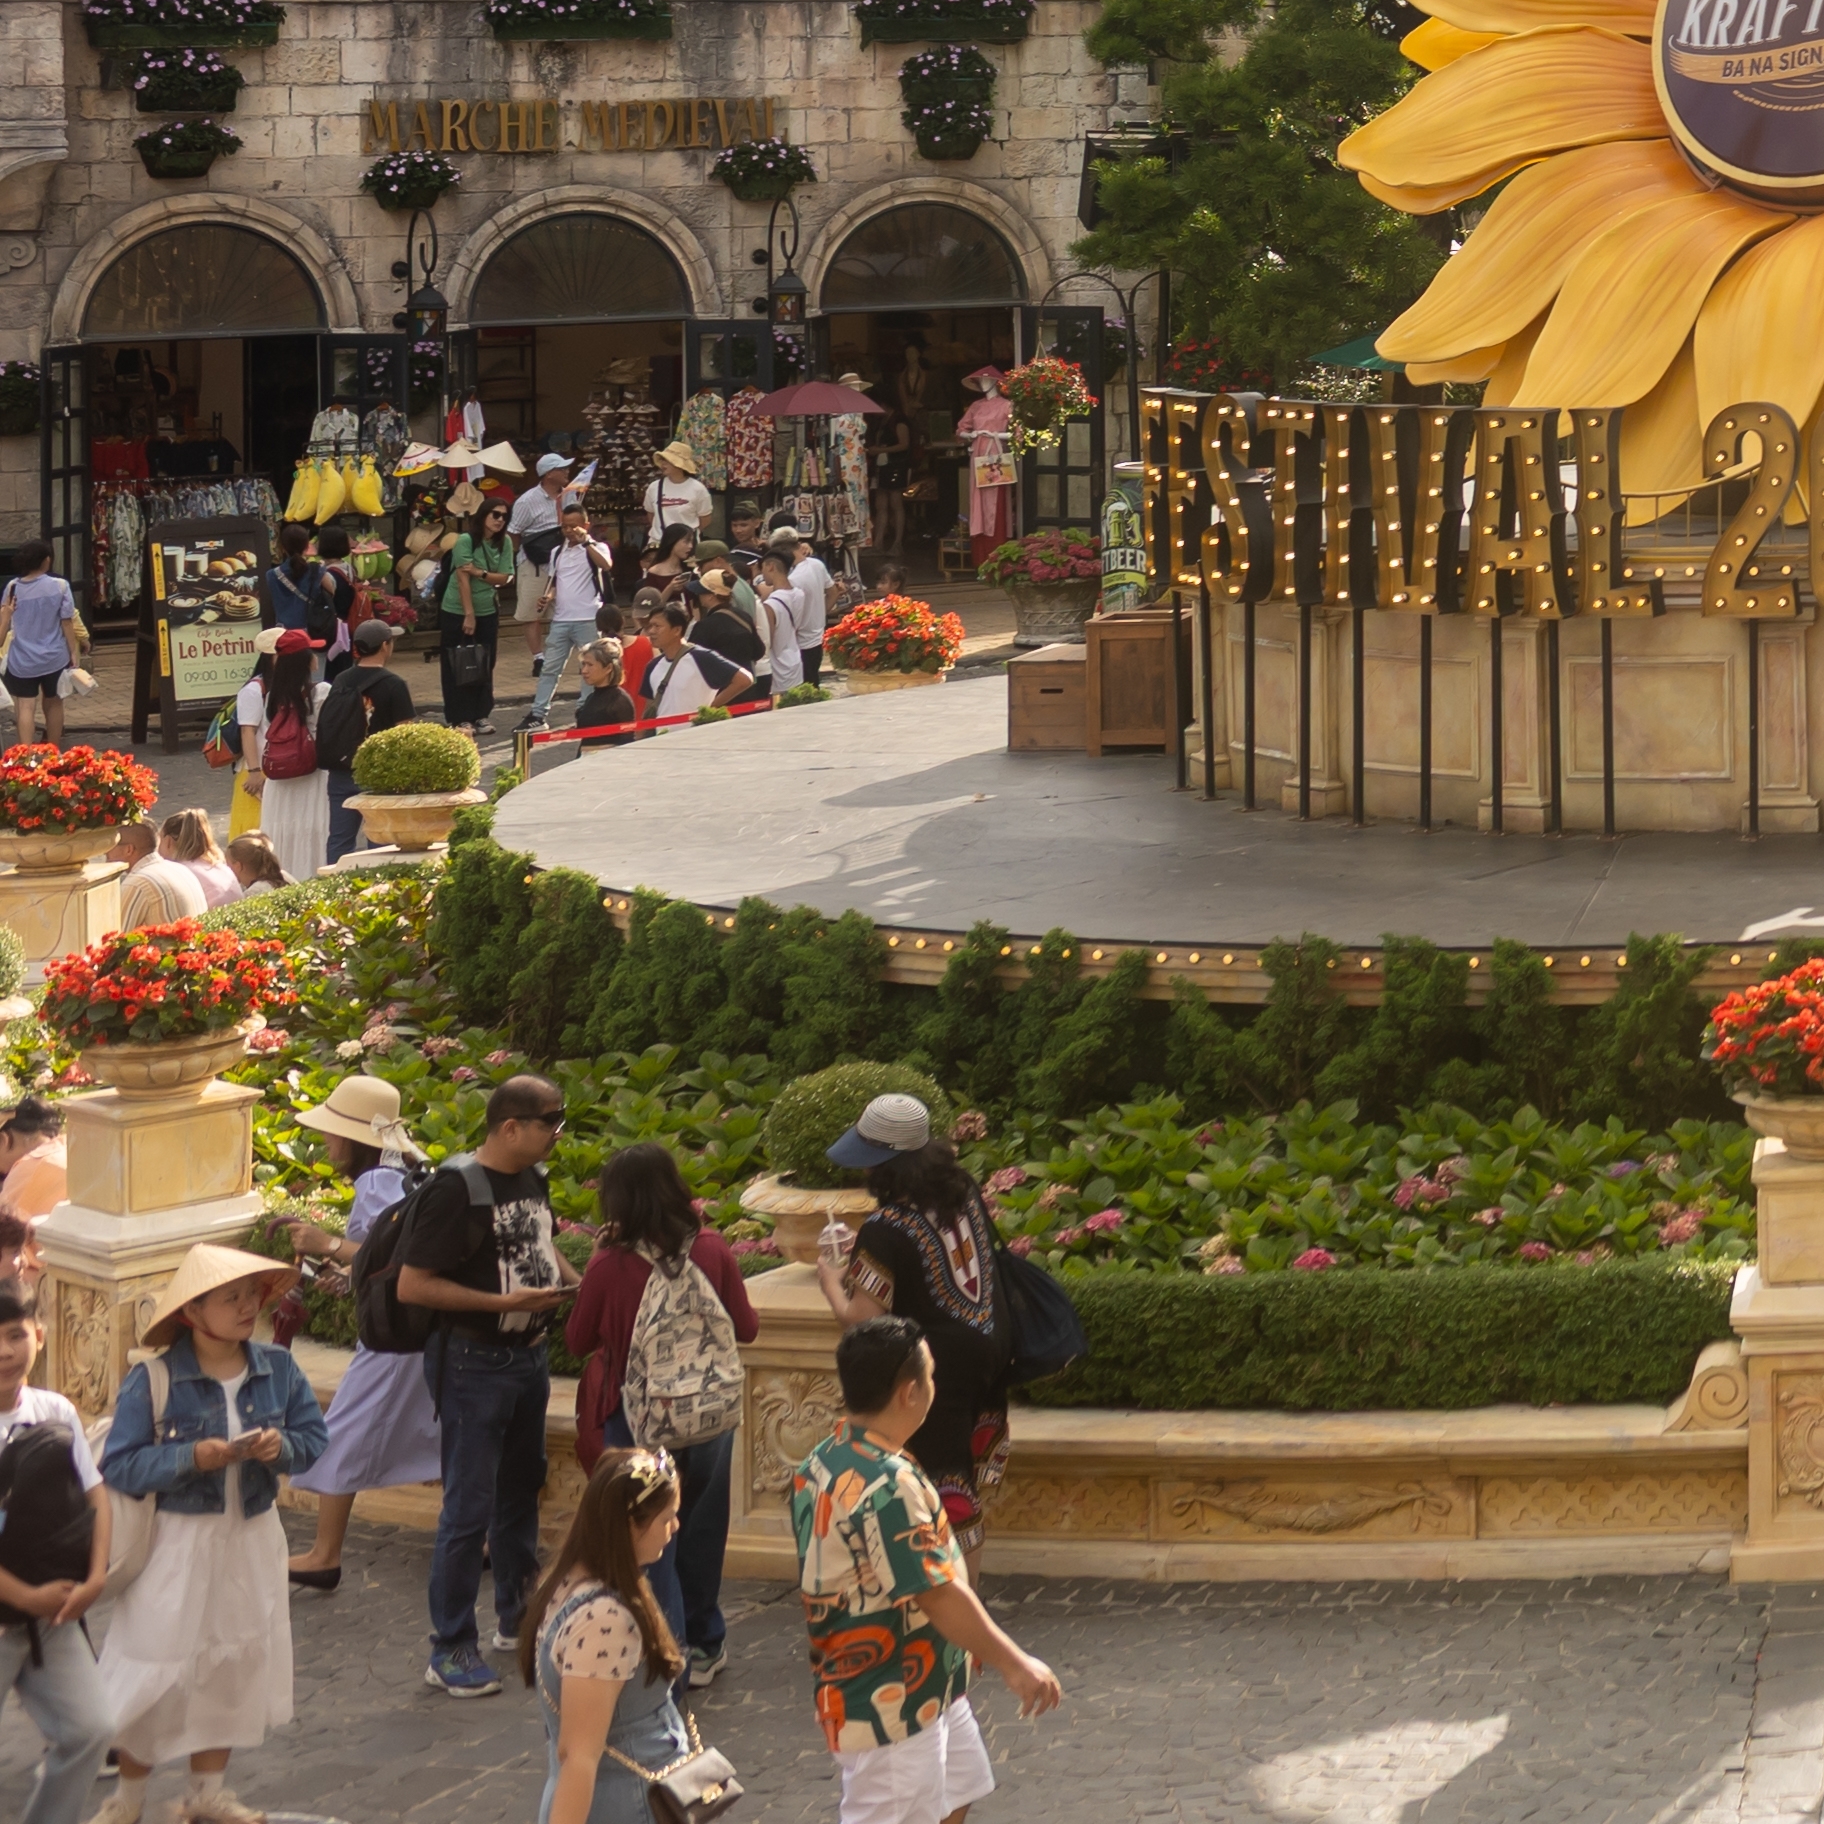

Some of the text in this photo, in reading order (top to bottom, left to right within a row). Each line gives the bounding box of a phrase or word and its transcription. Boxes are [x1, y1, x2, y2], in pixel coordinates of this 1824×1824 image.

[1721, 58, 1746, 79] BA
[1749, 55, 1774, 77] NA
[1140, 388, 1665, 619] FESTIVAL
[179, 637, 255, 659] Le Petrin
[184, 670, 218, 683] 09:00
